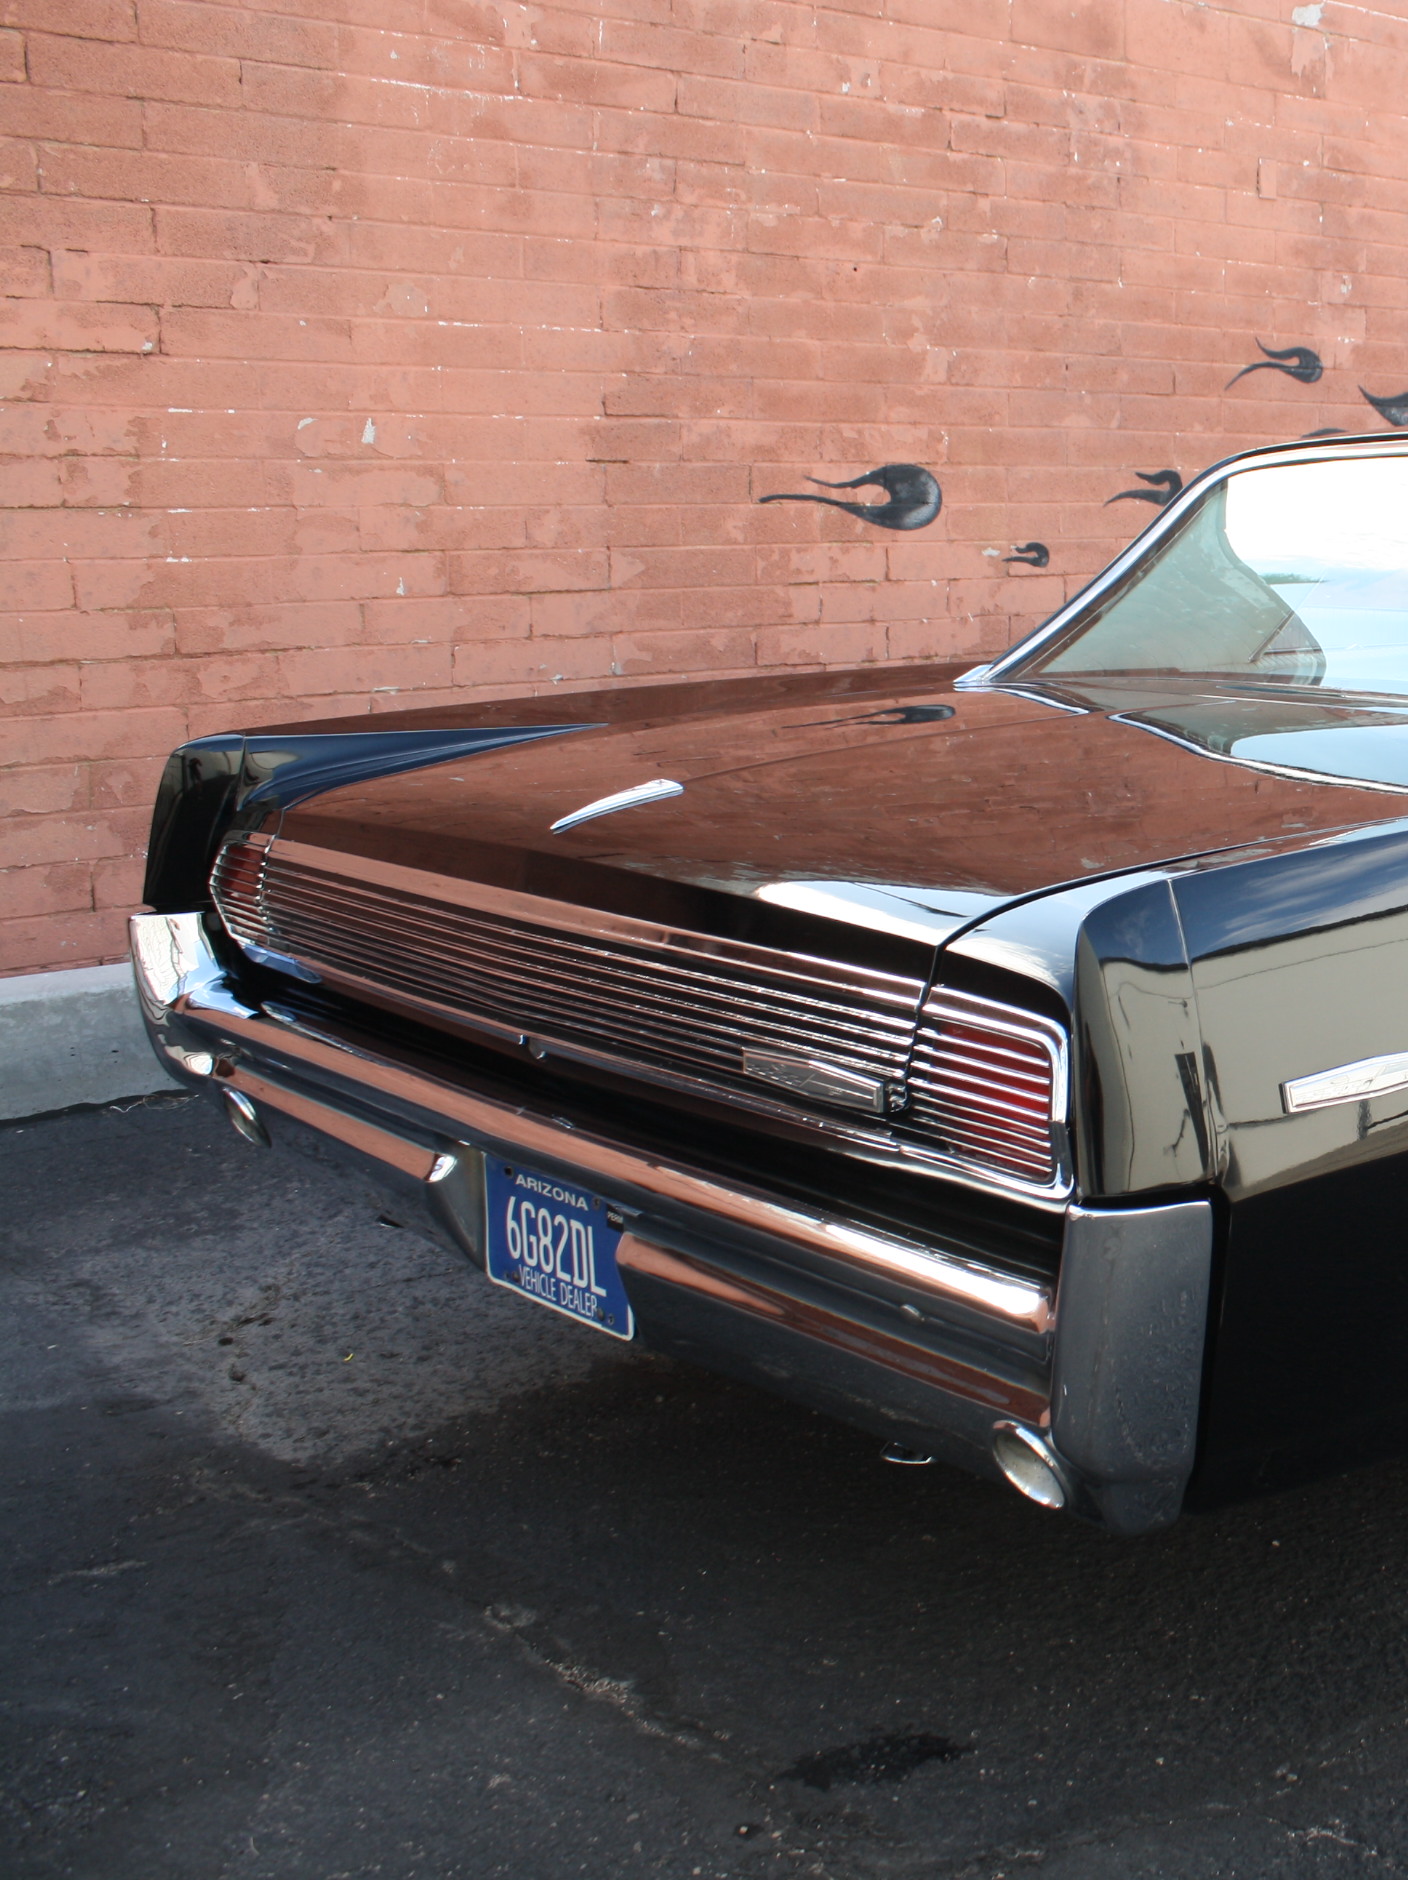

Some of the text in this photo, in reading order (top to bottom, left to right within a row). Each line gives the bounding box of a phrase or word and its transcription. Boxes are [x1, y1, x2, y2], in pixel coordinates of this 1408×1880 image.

[516, 1174, 588, 1211] ARIZONA
[506, 1195, 607, 1298] 6G82DL
[519, 1264, 598, 1319] VEHICLE DEALER
